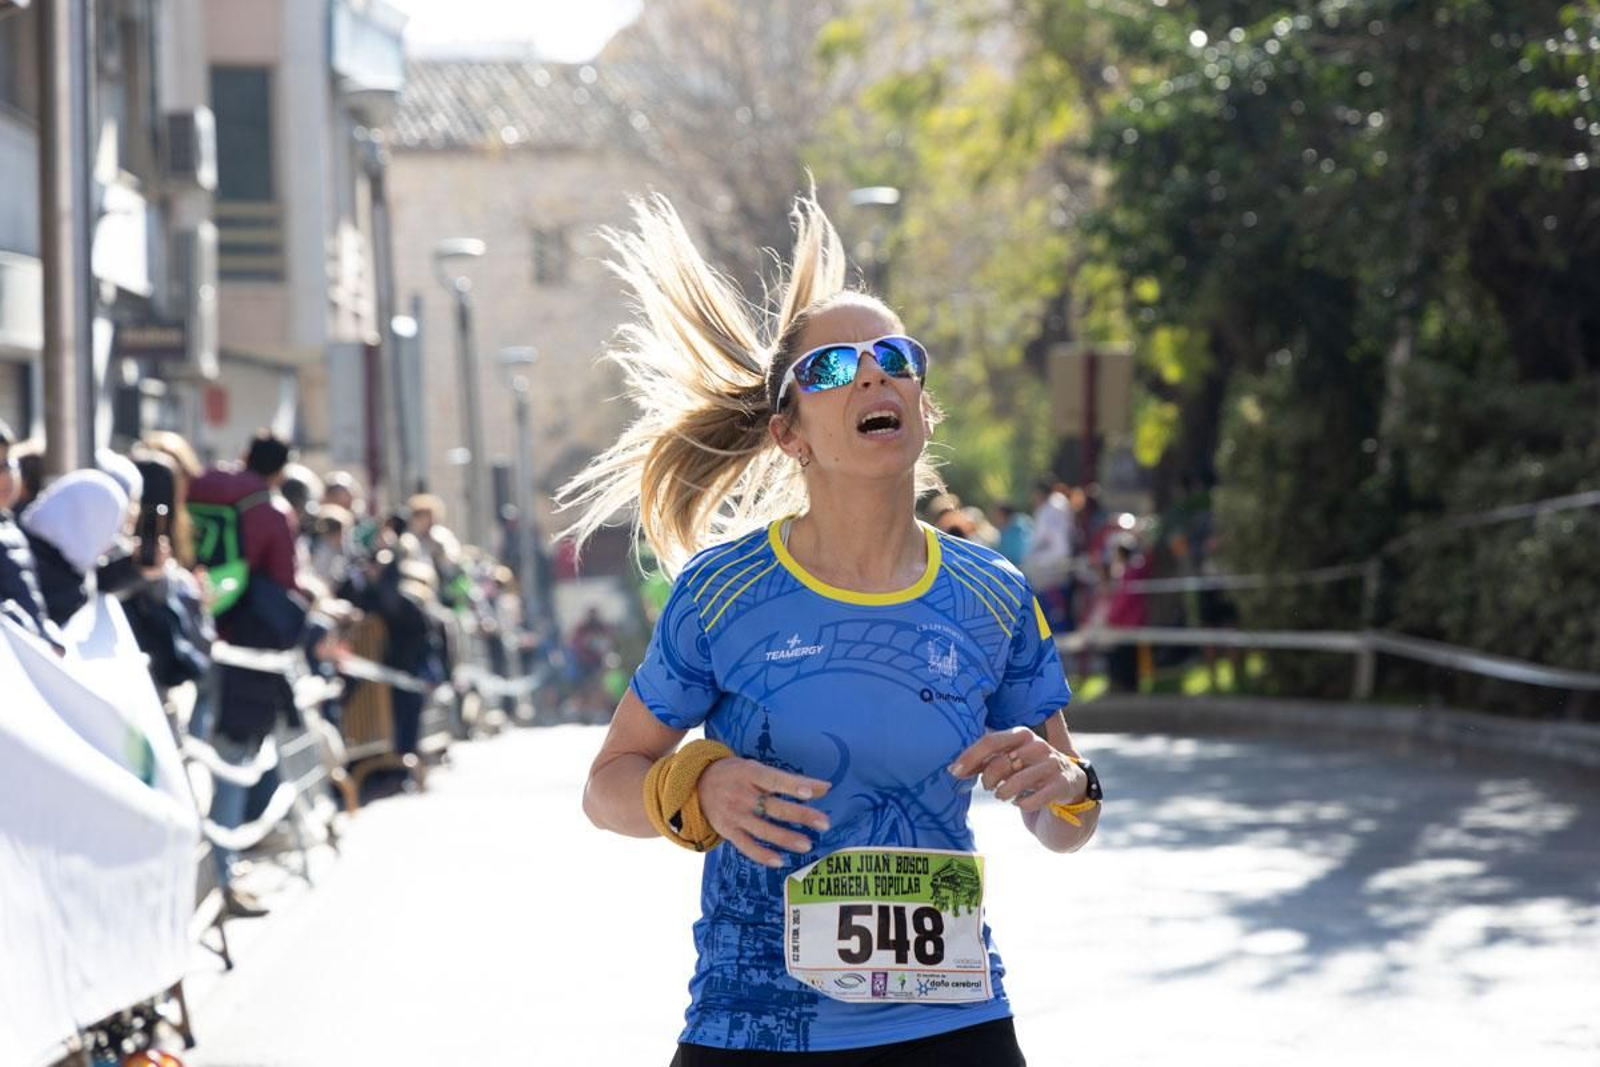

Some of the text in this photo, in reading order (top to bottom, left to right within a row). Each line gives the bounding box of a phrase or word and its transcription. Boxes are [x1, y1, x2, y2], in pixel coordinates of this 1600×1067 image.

[766, 645, 824, 661] TEAMERGY
[826, 855, 852, 875] SAN
[896, 855, 929, 875] BOSCO
[803, 875, 921, 897] IV CARRERA POPULAR
[837, 904, 945, 966] 548
[930, 979, 982, 989] daño cerebral
